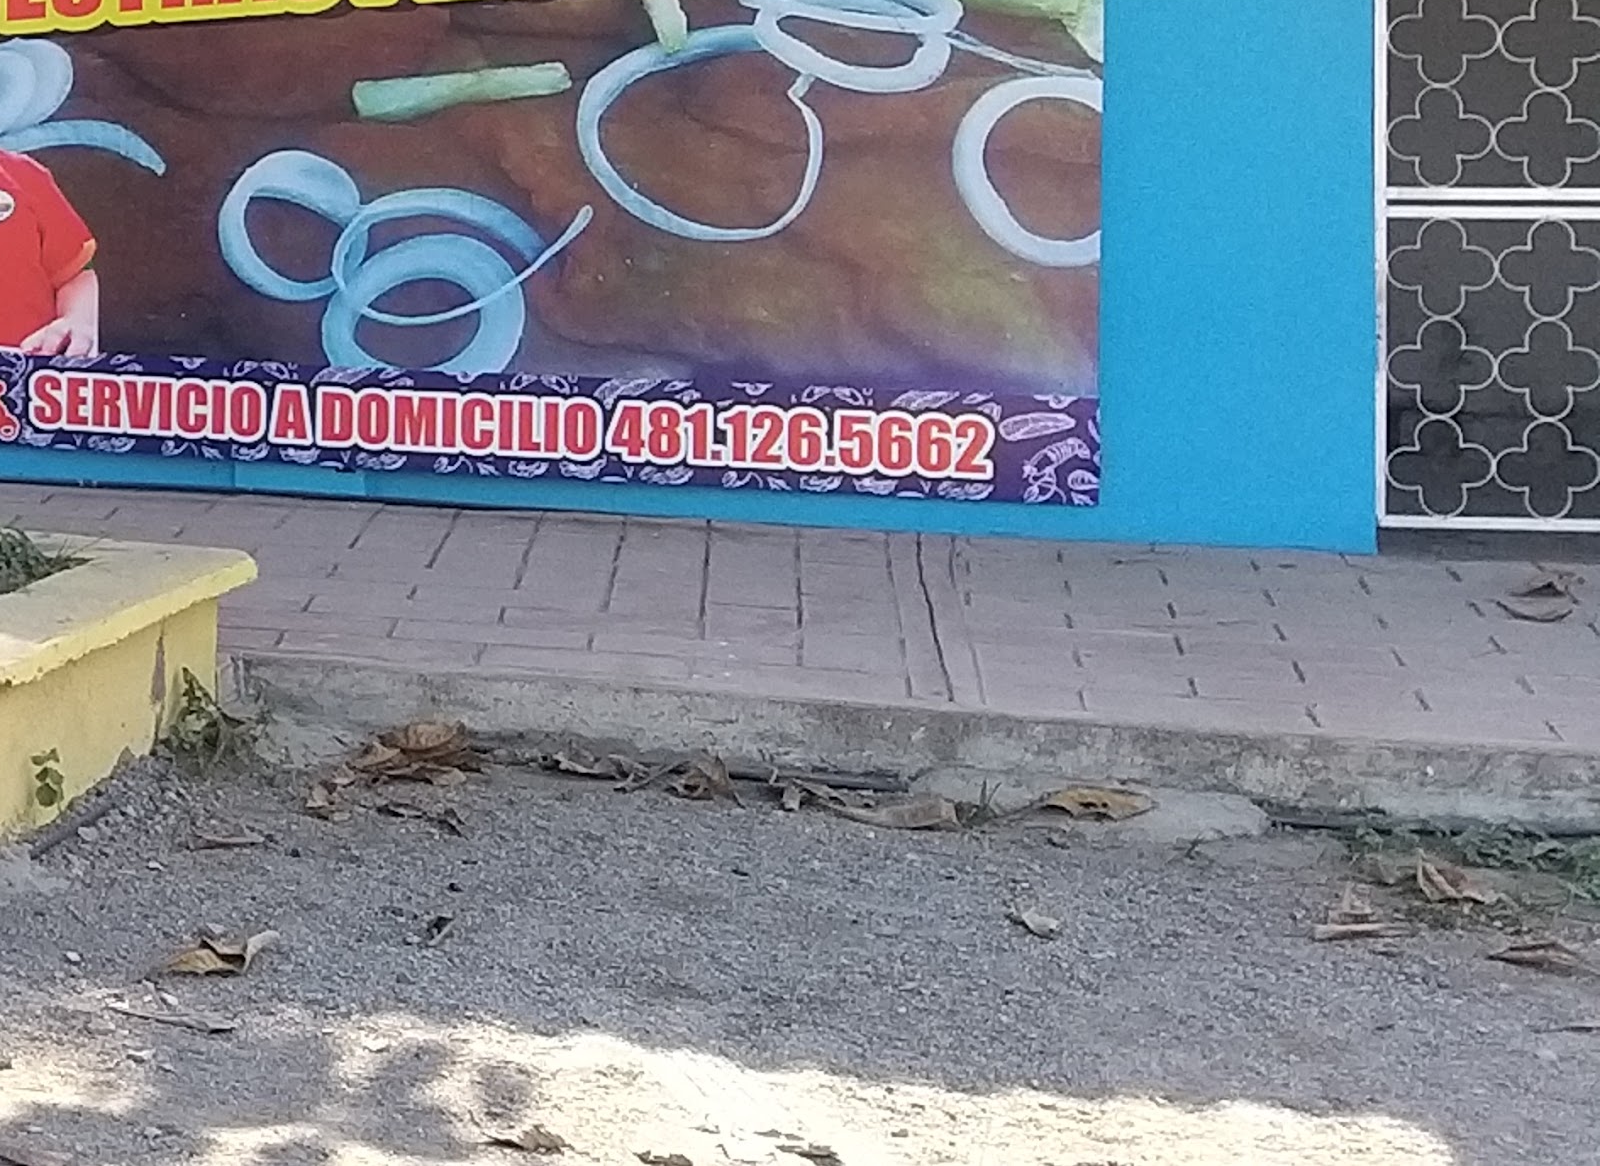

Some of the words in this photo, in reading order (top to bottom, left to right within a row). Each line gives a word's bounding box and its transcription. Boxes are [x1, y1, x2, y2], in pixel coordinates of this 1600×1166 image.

[33, 375, 262, 436] SERVICIO
[274, 387, 307, 439] A
[320, 389, 598, 456] DOMICILIO
[611, 404, 994, 477] 481.126.5662
